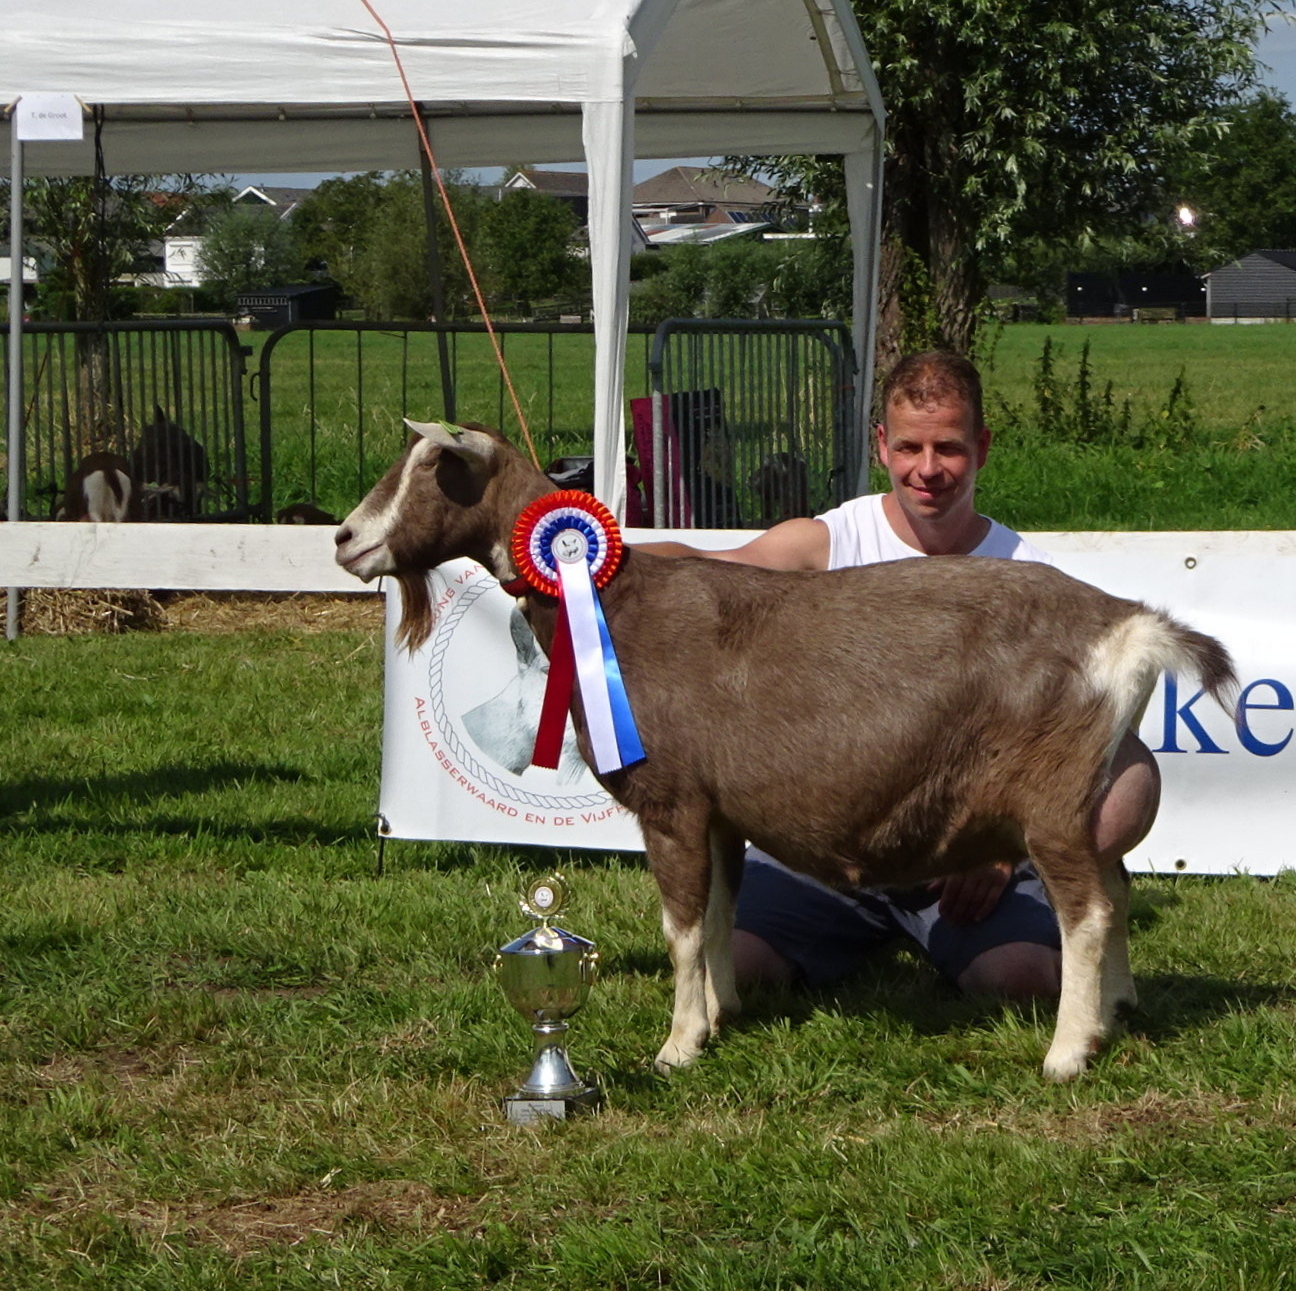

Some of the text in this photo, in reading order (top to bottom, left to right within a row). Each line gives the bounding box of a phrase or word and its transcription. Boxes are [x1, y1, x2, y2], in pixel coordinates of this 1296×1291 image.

[414, 696, 519, 818] ALBLASSERWAARD
[524, 812, 546, 825] EN
[553, 816, 575, 826] DE
